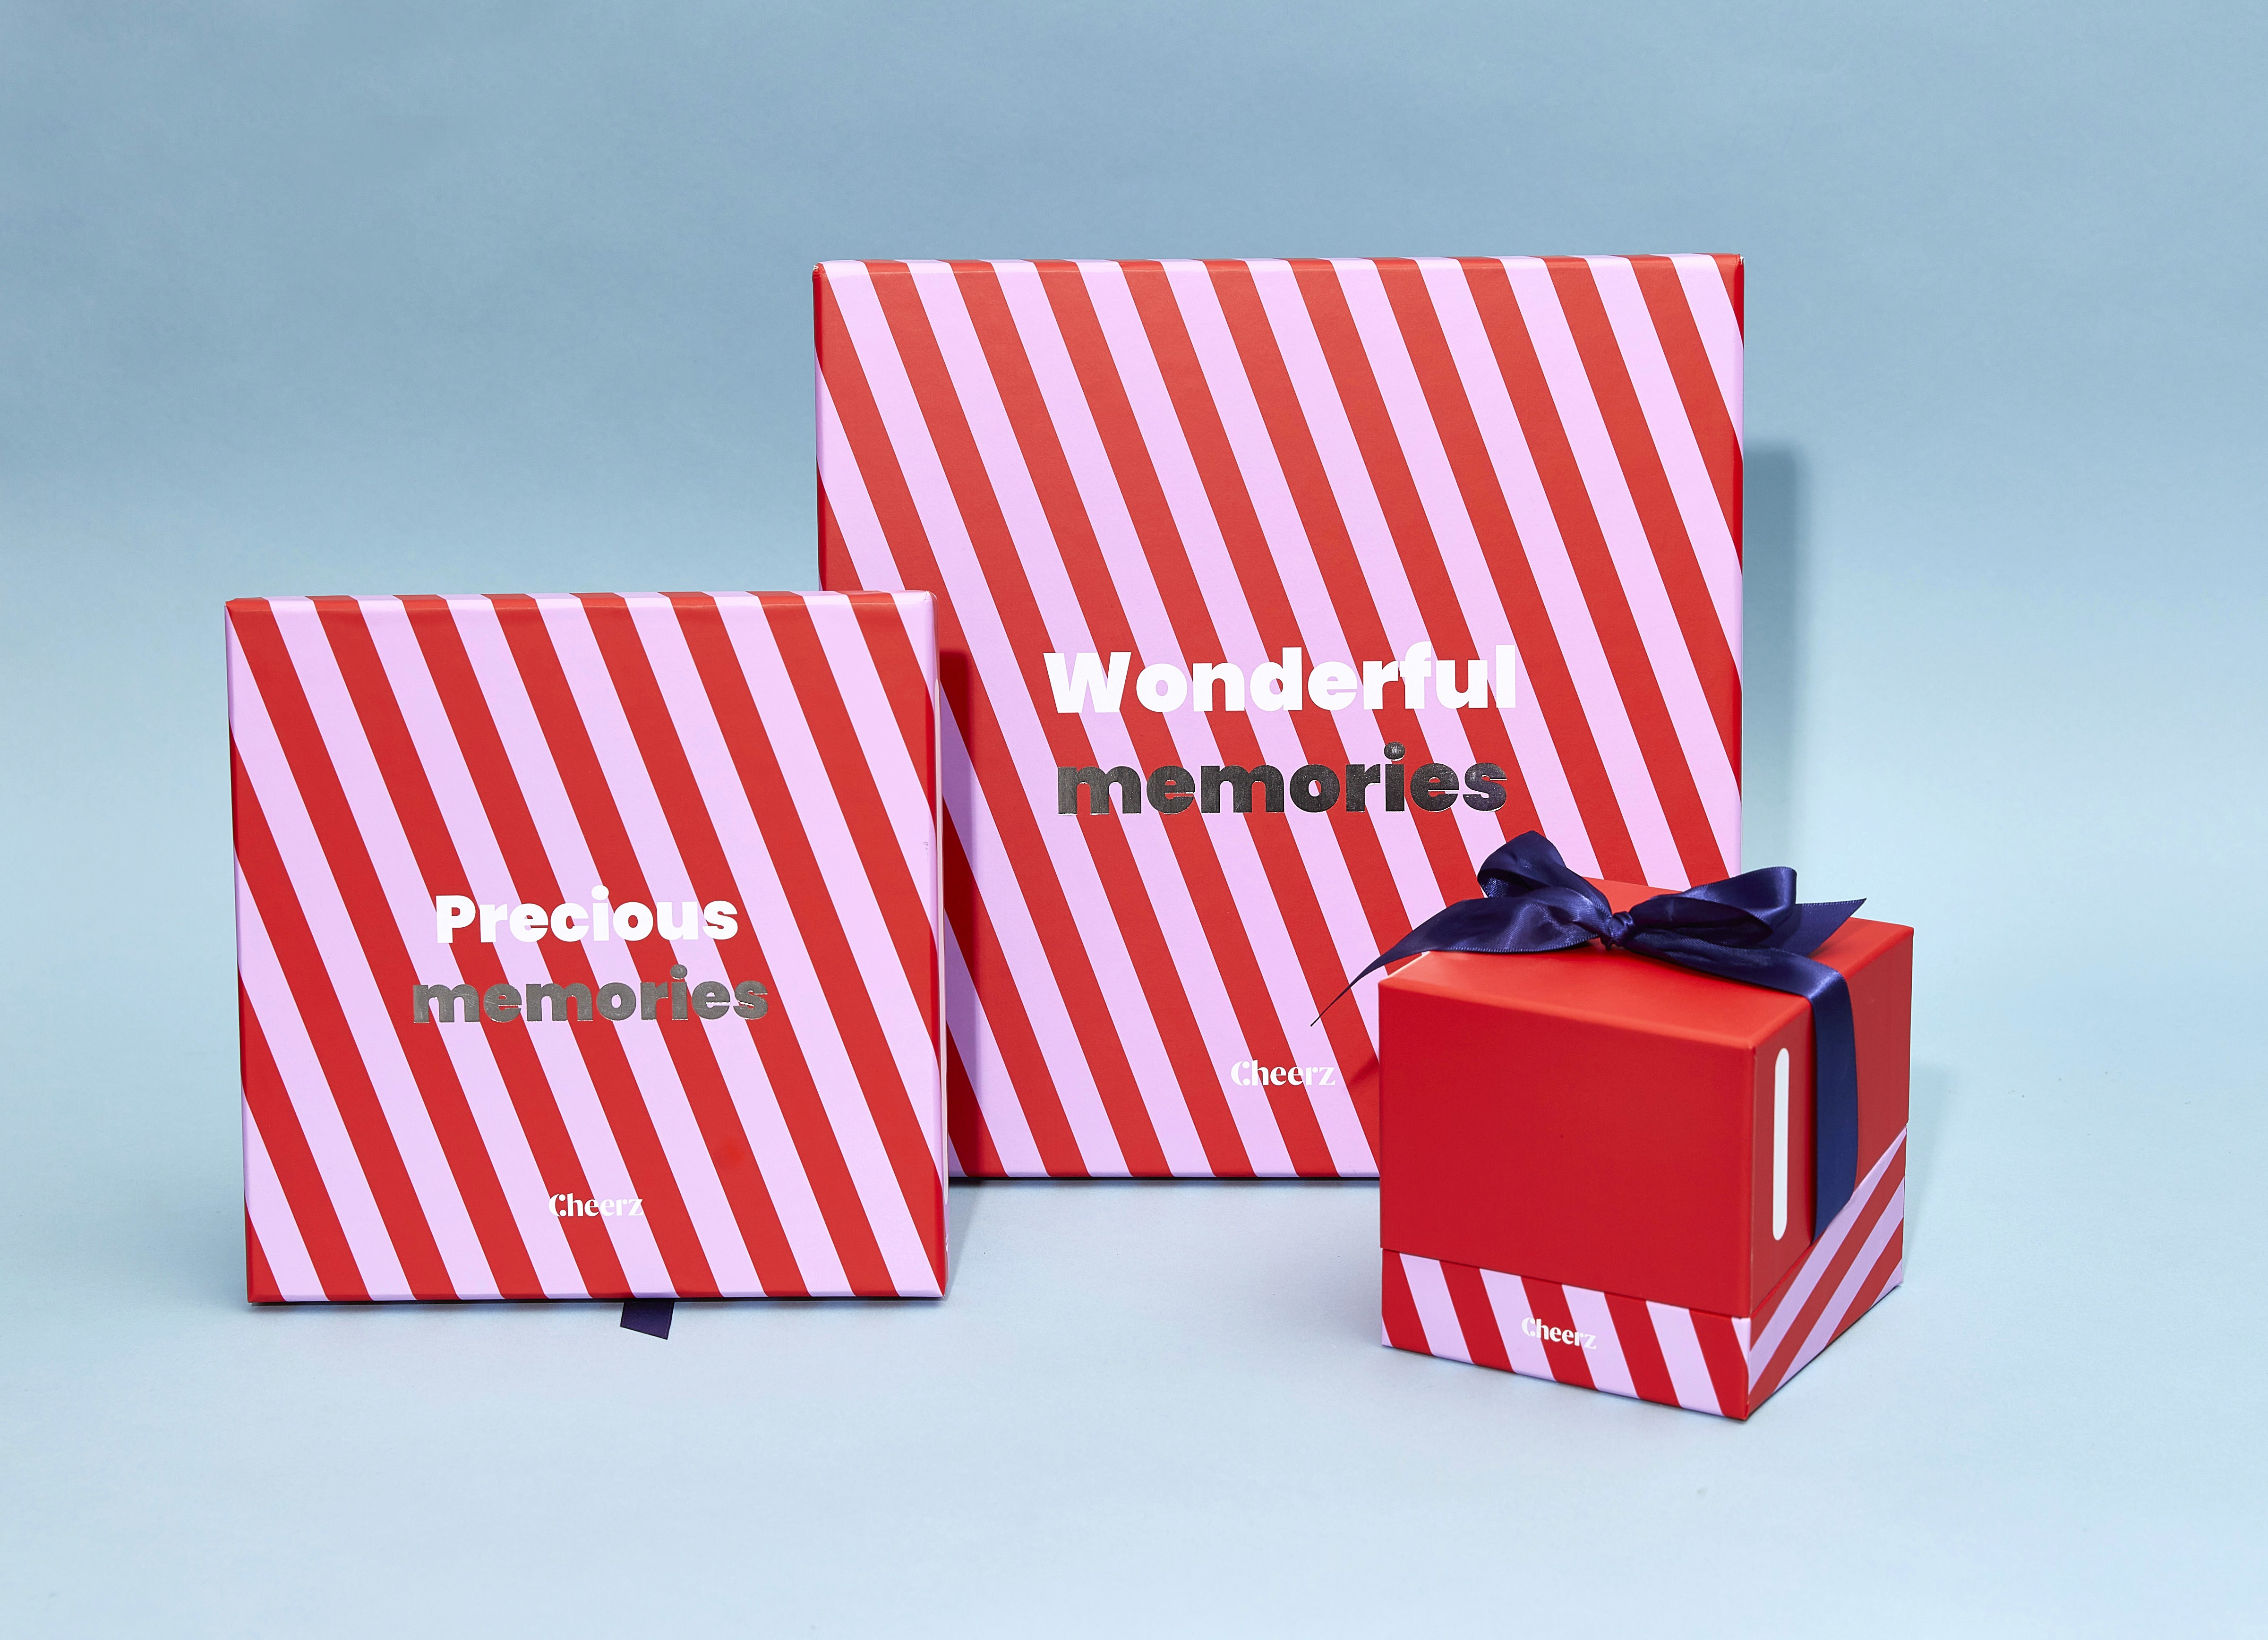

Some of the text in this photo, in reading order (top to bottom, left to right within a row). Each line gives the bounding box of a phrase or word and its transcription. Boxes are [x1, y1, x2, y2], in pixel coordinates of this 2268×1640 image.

[1043, 641, 1516, 713] Wonderful
[1058, 742, 1507, 815] memories
[436, 885, 738, 943] Precious
[413, 964, 769, 1023] memories
[1231, 1059, 1335, 1086] Cheerz
[548, 1193, 644, 1216] Cheerz
[1522, 1317, 1596, 1350] Cheerz
